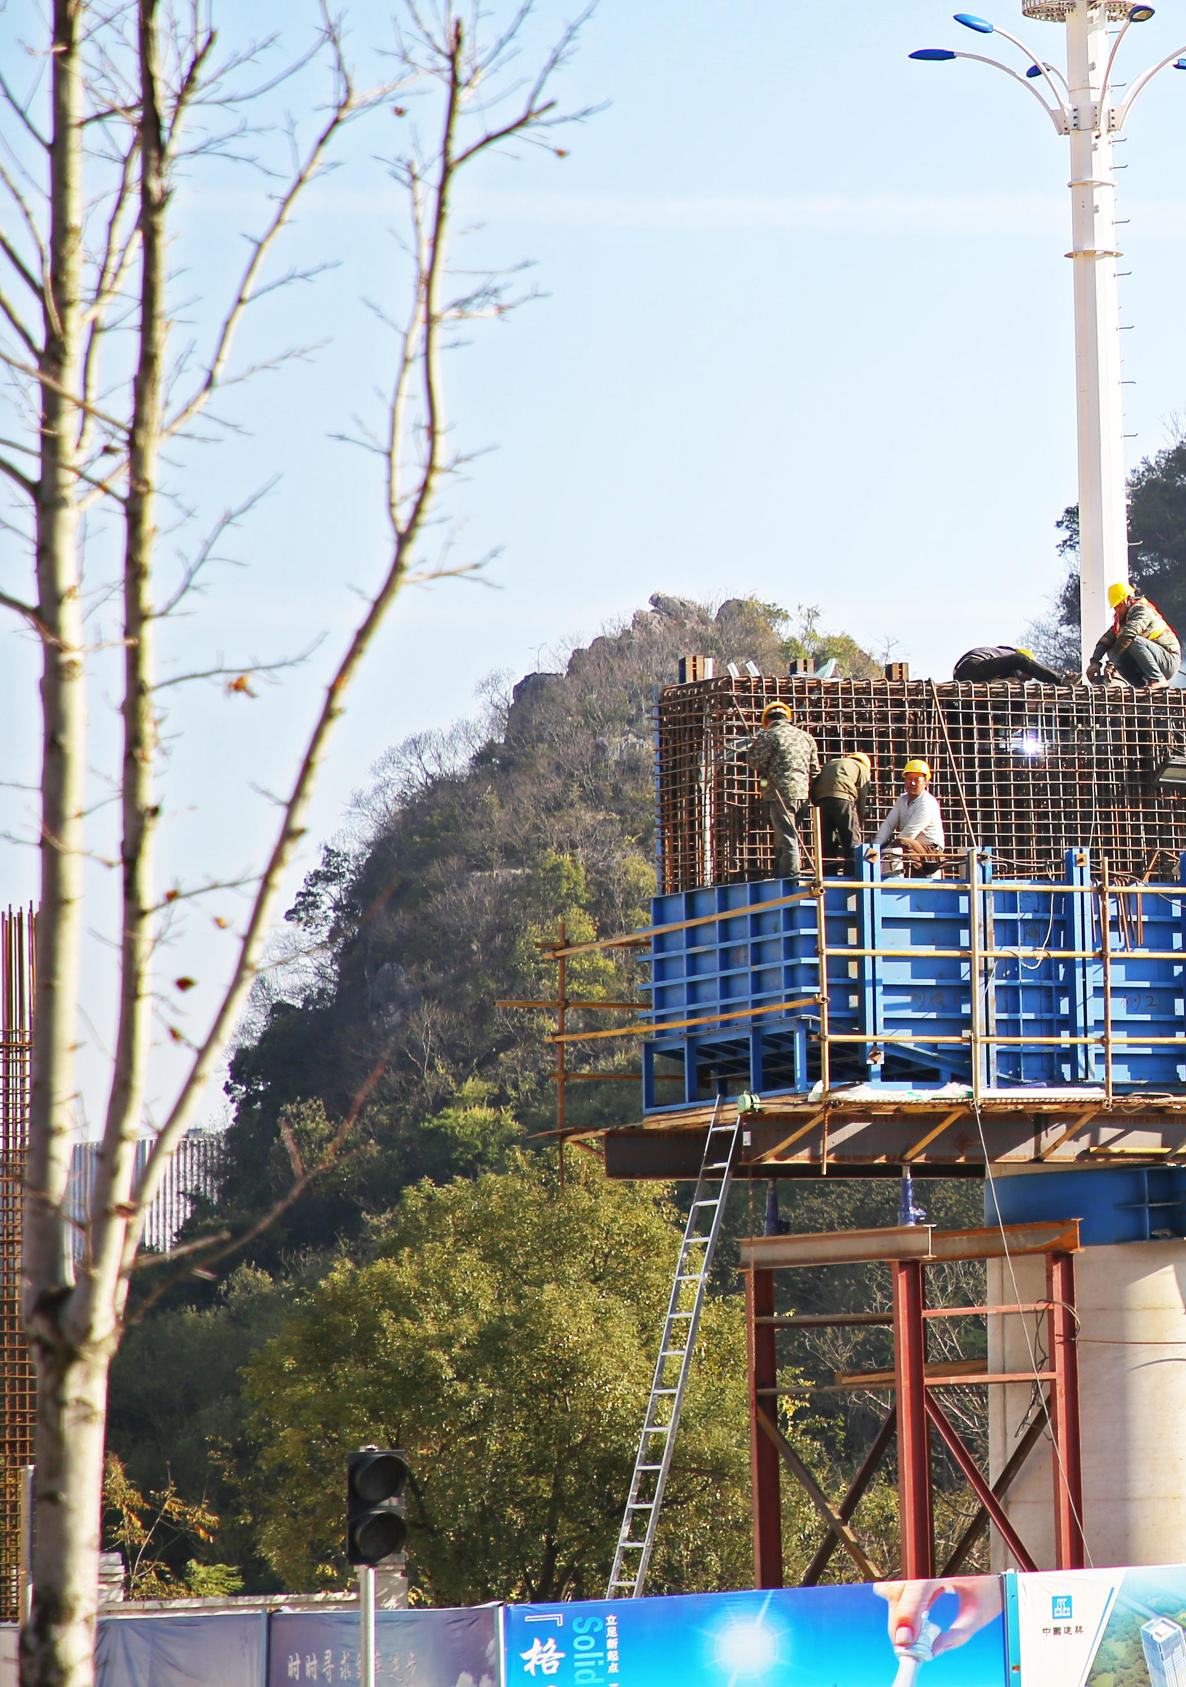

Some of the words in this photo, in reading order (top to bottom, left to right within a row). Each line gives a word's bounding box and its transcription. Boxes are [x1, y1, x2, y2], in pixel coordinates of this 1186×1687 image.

[572, 1616, 605, 1685] Solid
[605, 1614, 619, 1674] 立足新起点
